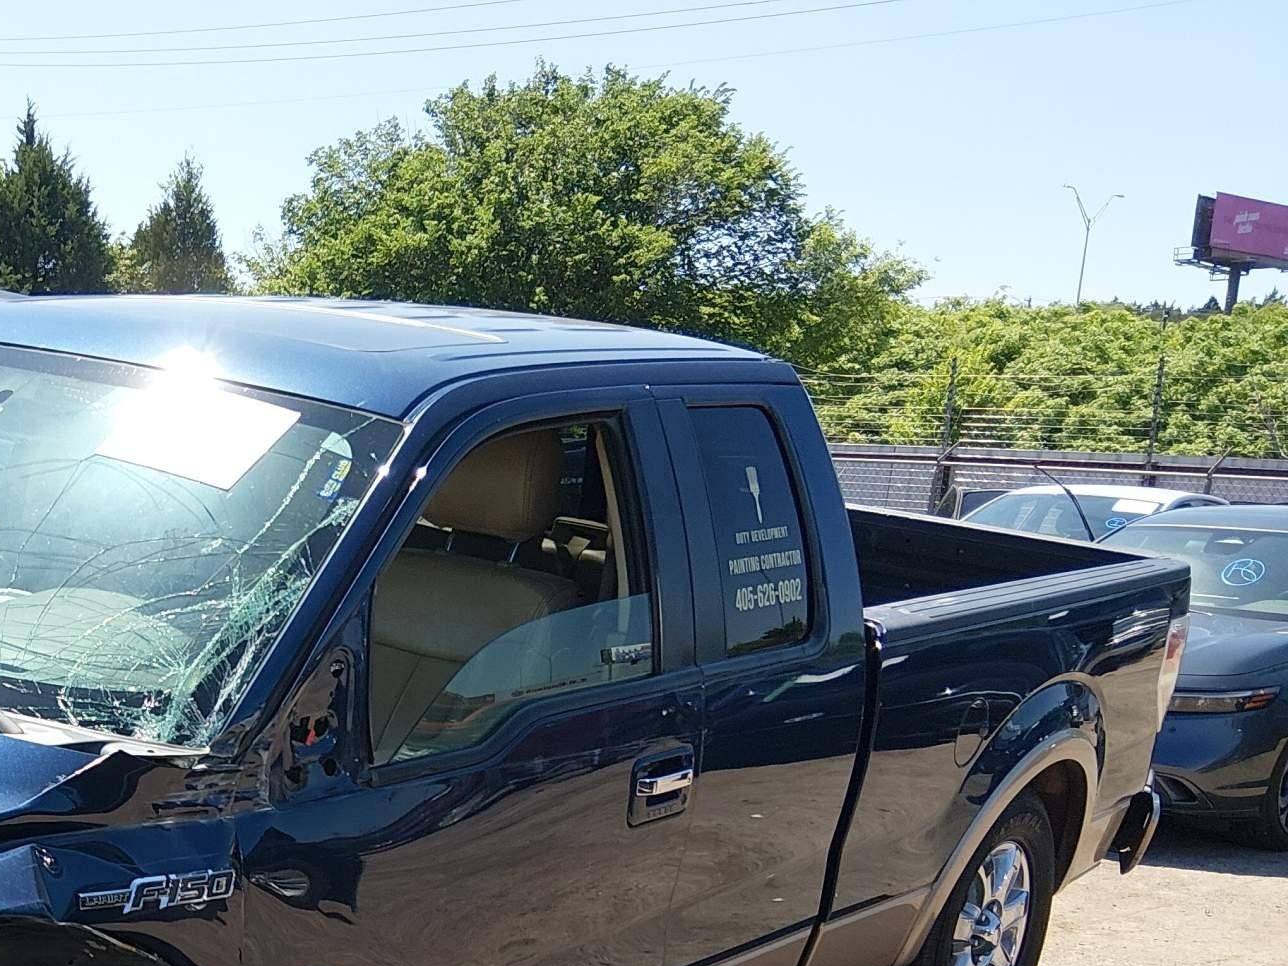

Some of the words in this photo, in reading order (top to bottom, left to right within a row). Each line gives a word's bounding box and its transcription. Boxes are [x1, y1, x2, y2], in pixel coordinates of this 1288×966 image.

[751, 526, 789, 542] DEVELOPMENT
[728, 556, 760, 576] PAINTING
[761, 549, 802, 570] CONTRACTOR
[735, 578, 803, 612] 405-626-0902
